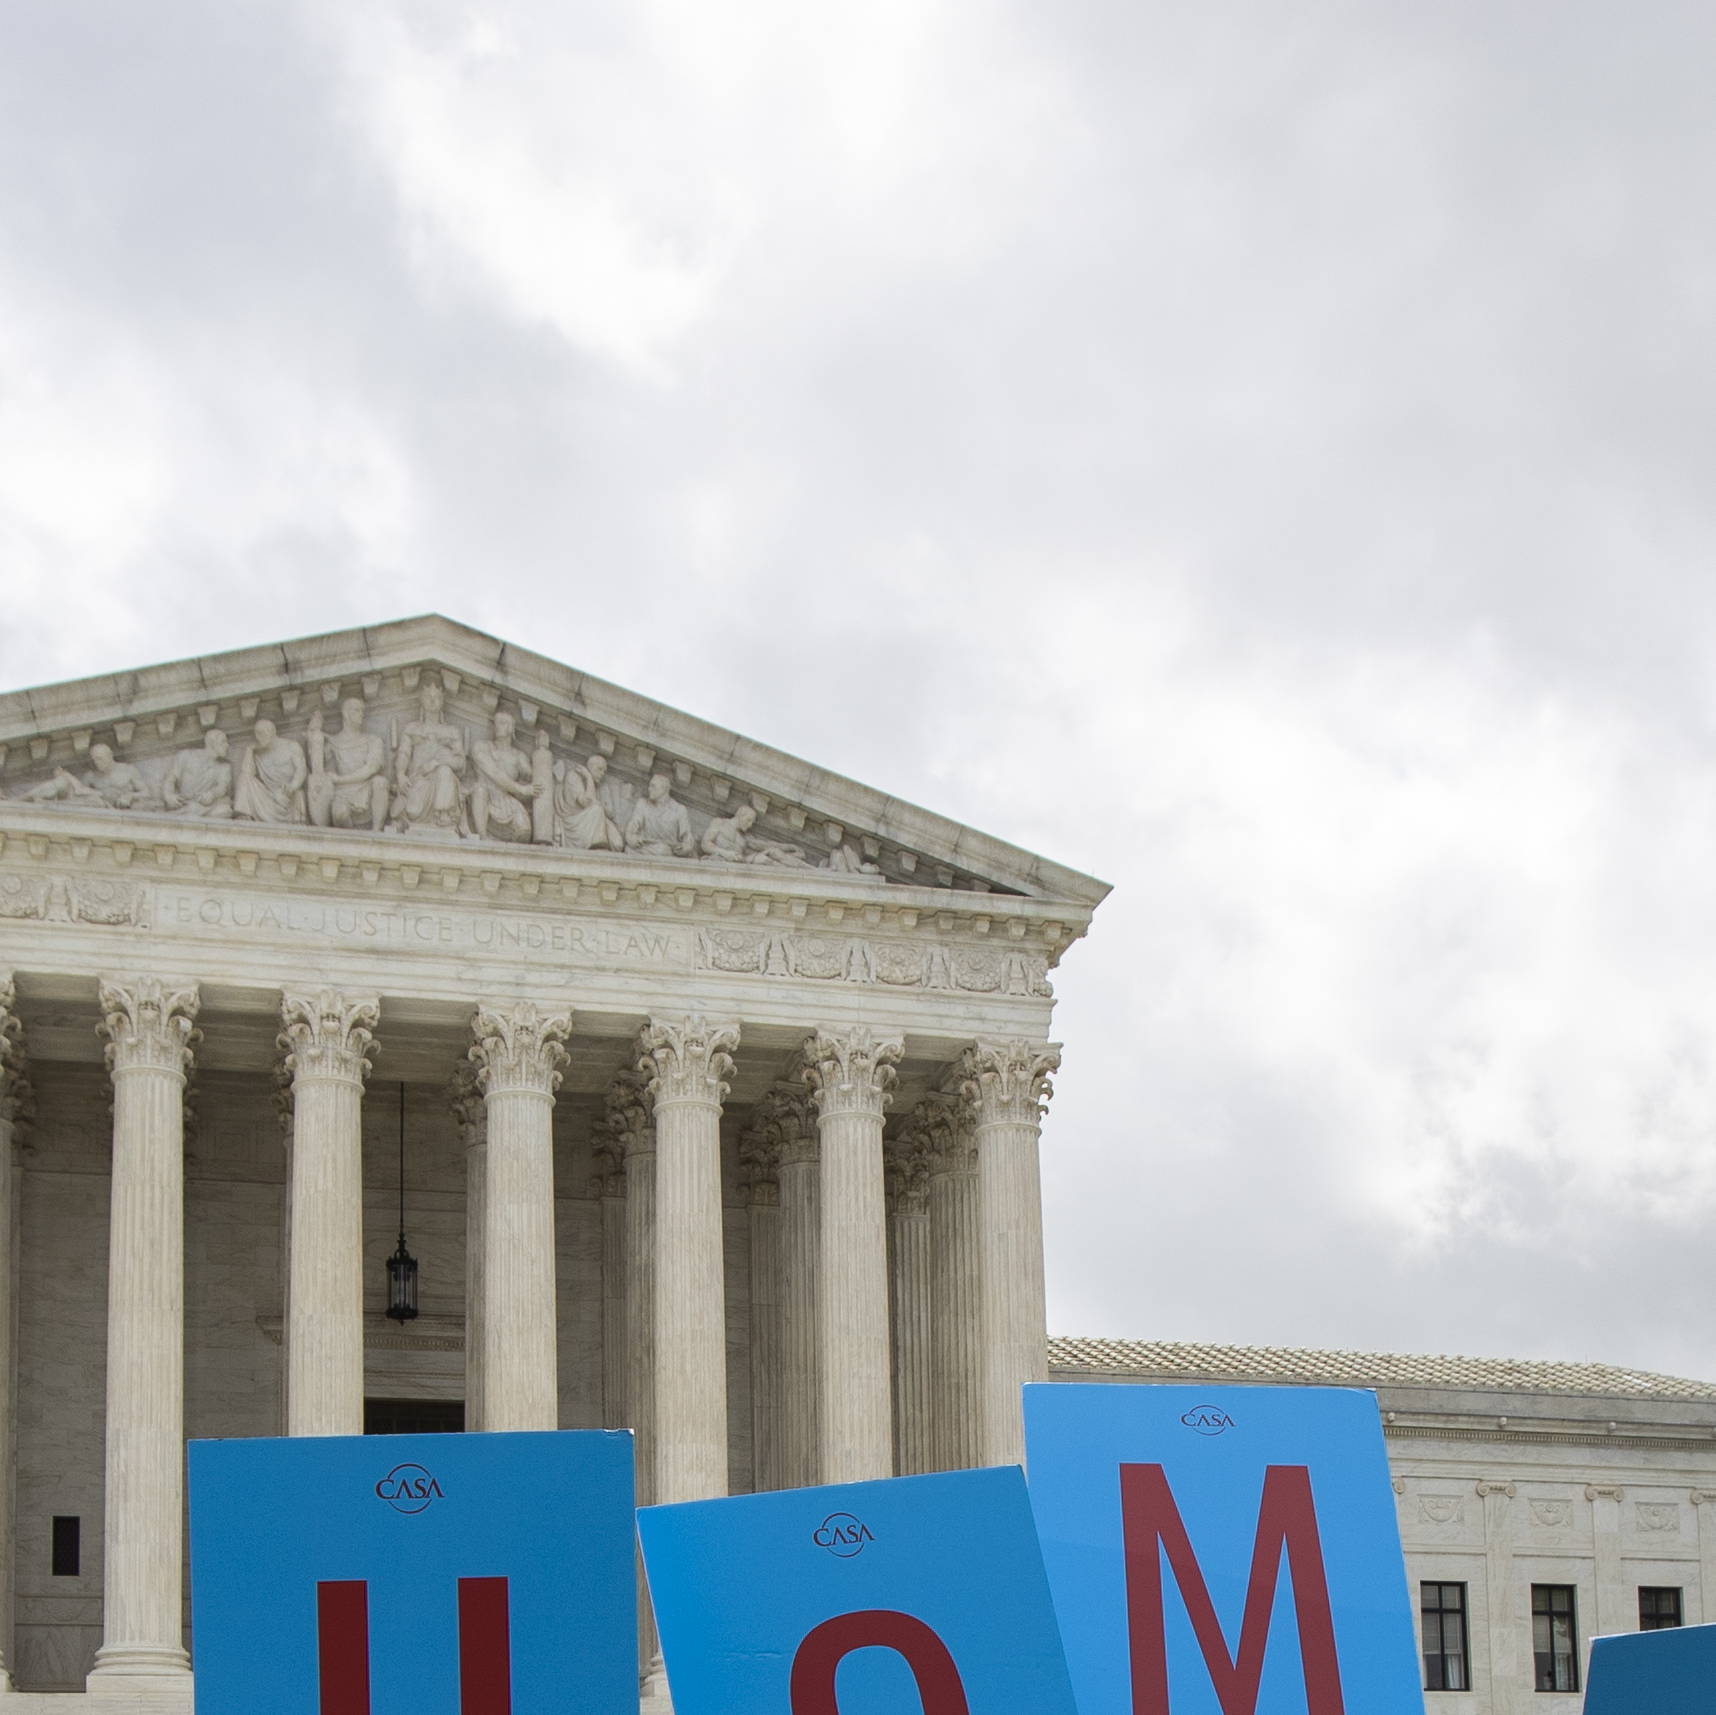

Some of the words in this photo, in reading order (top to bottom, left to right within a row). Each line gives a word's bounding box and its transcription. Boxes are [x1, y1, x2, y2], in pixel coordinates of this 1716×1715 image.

[176, 898, 301, 930] EQUAL
[310, 906, 453, 942] JUSTICE
[472, 920, 593, 951] UNDER
[604, 930, 671, 957] LAW
[375, 1478, 445, 1499] CASA
[813, 1523, 876, 1547] CASA
